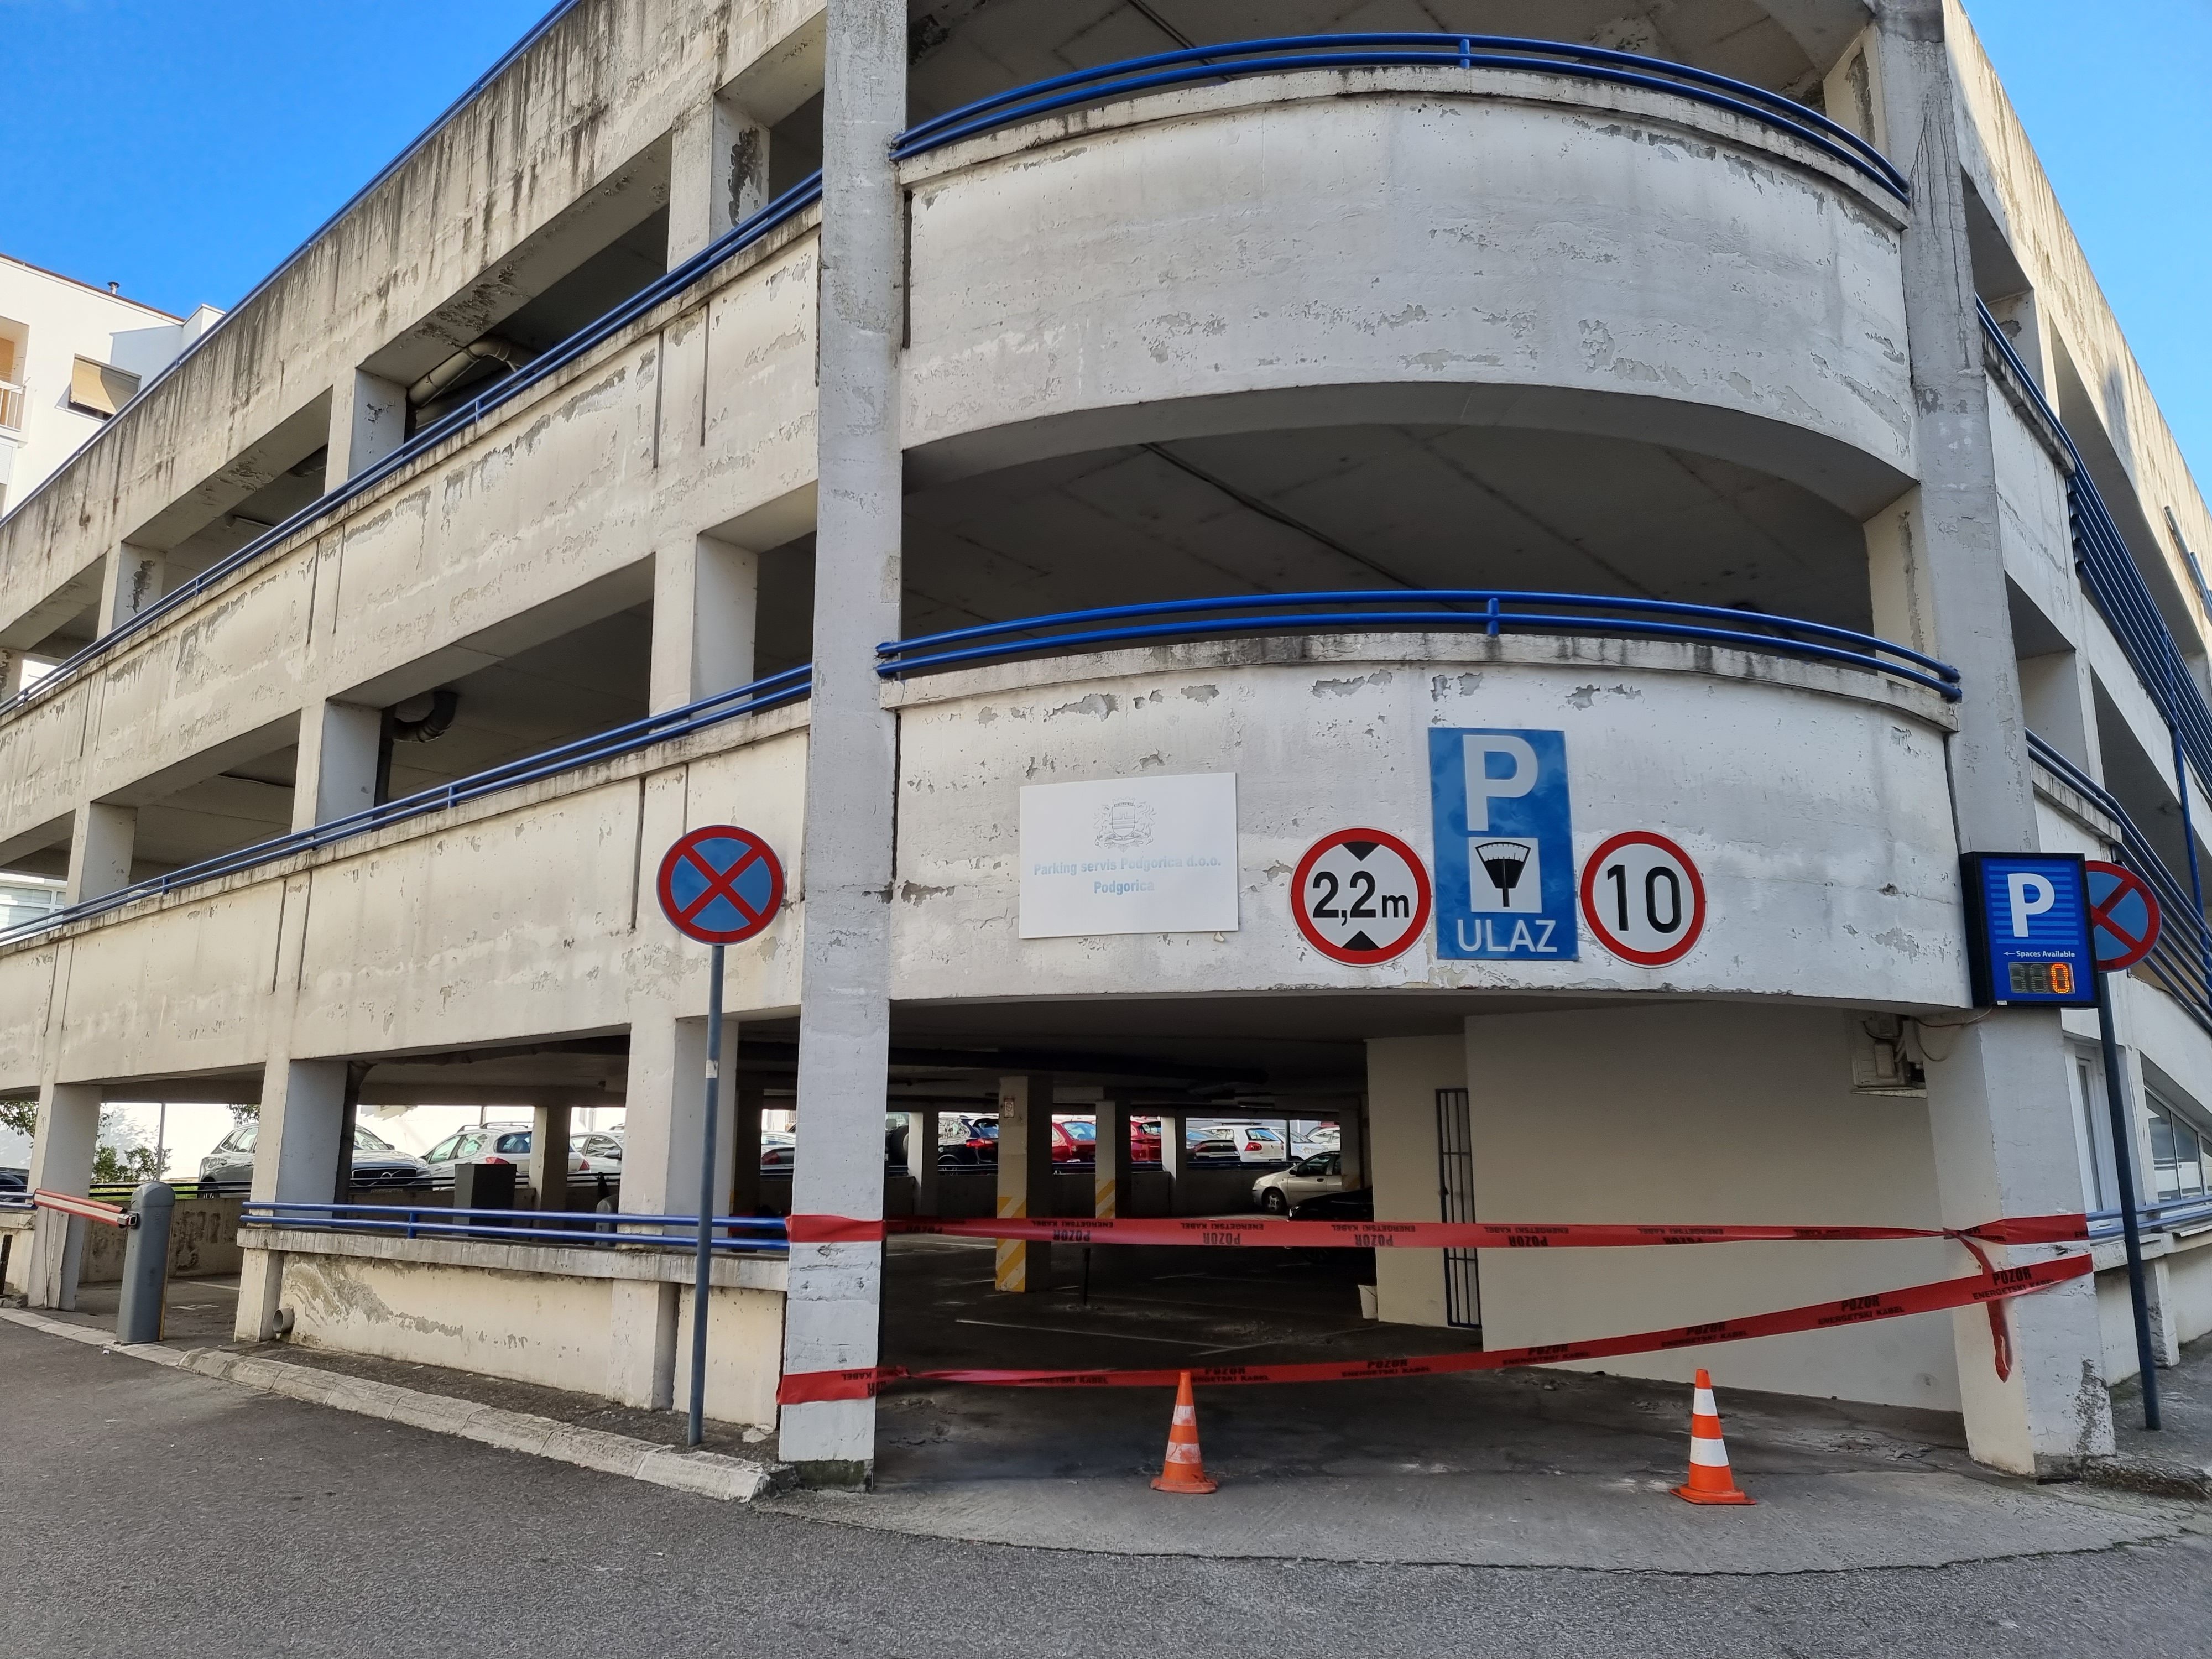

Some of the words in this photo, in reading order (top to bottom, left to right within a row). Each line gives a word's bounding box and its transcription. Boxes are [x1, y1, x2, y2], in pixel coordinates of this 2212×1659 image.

[1463, 734, 1538, 831] P
[1034, 861, 1077, 875] Parking
[1081, 859, 1117, 872] servis
[1120, 857, 1182, 872] Podgorica
[1187, 855, 1222, 867] d.o.o.
[1094, 879, 1155, 895] Podgorica
[1607, 864, 1682, 933] 10
[2007, 873, 2055, 937] P
[1458, 920, 1557, 953] ULAZ
[2016, 950, 2041, 958] Spaces
[1053, 1230, 1090, 1241] POZOR
[1203, 1233, 1240, 1244] POZOR
[1355, 1234, 1393, 1246] POZOR
[1509, 1236, 1548, 1246] POZOR
[1993, 1267, 2032, 1285] POZOR
[1973, 1284, 2026, 1300] ENERGETSKI
[1841, 1295, 1880, 1312] POZOR
[1818, 1311, 1872, 1324] ENERGETSKI
[1876, 1306, 1904, 1315] KABEL
[1687, 1322, 1726, 1335] POZOR
[842, 1372, 872, 1381] KABEL
